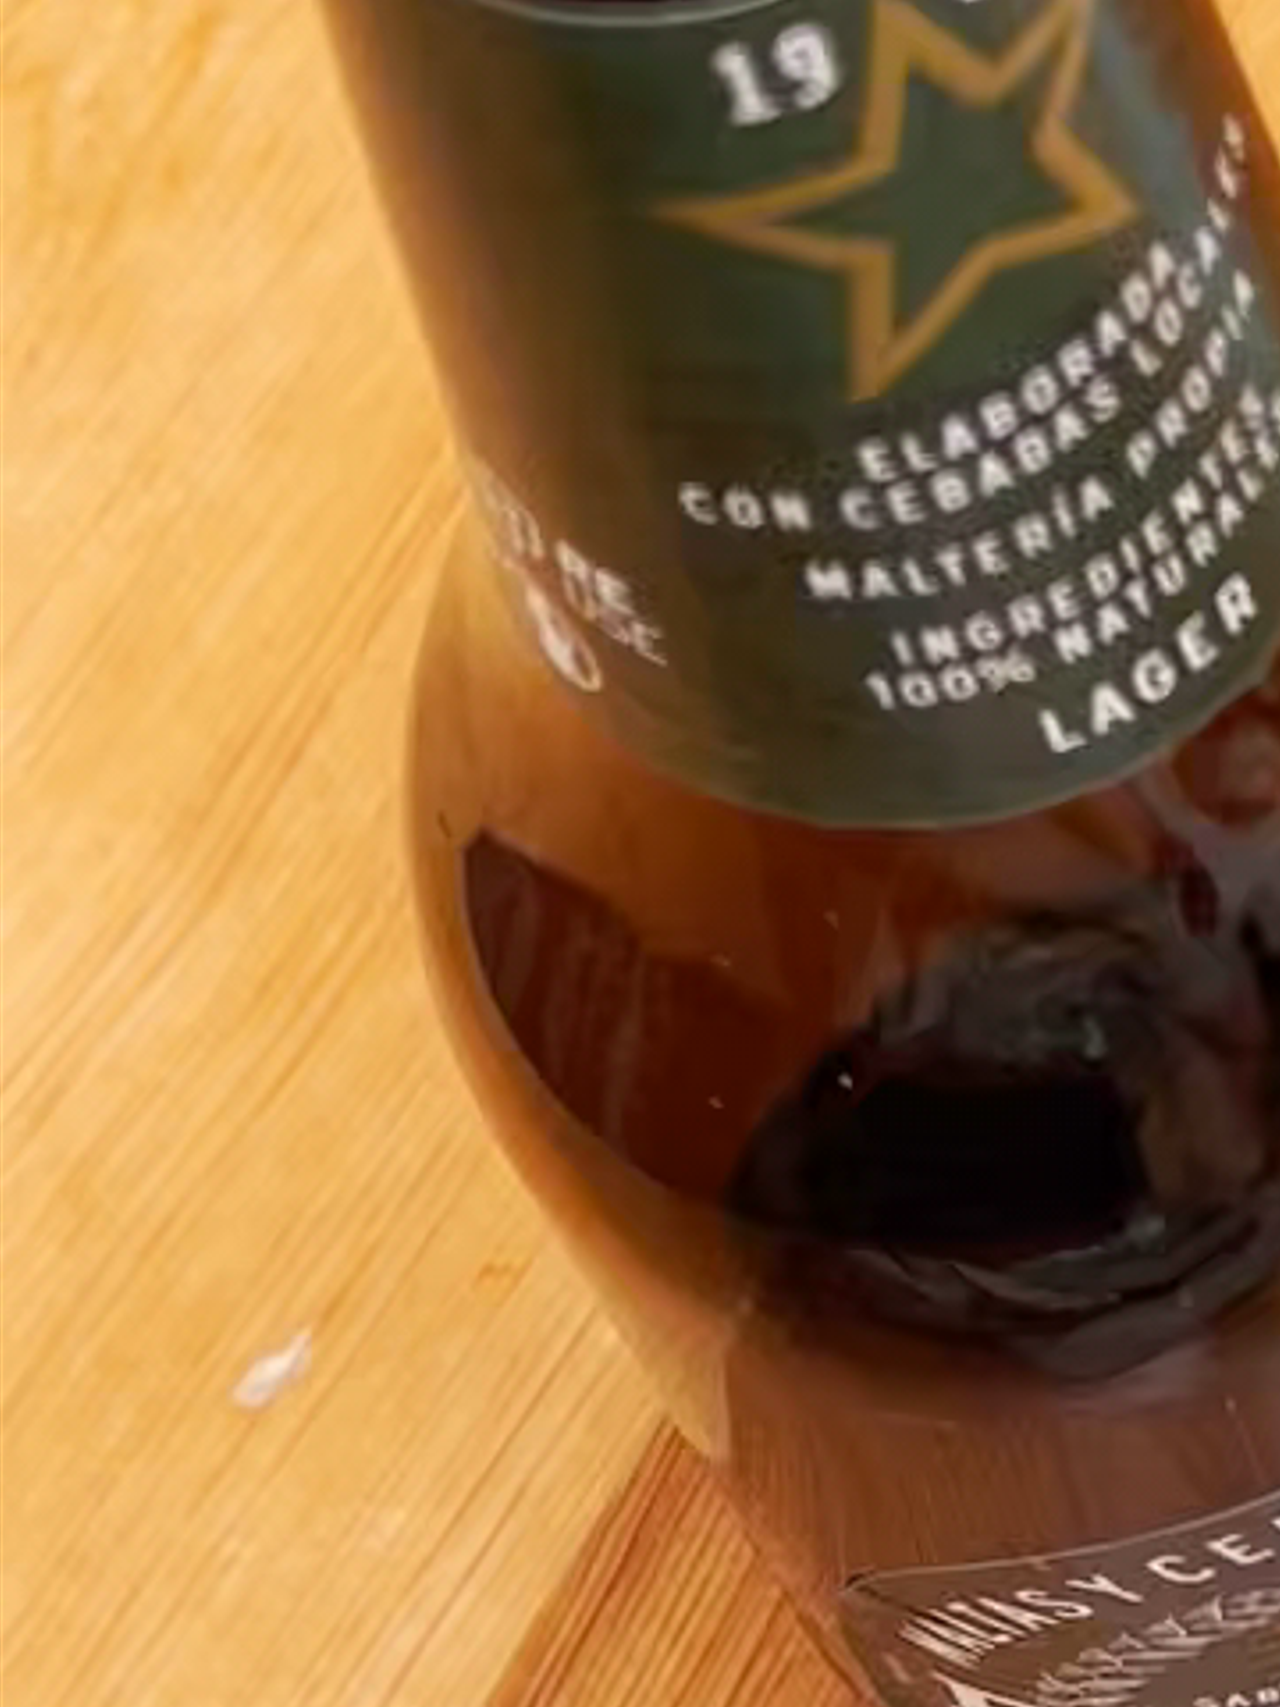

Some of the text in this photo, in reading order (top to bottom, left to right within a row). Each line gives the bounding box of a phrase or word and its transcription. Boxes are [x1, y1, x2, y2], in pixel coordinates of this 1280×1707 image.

[711, 22, 840, 126] 19
[857, 239, 1176, 483] ELABORADA
[1125, 268, 1255, 480] PROPIA
[678, 480, 812, 532] CON
[838, 371, 1121, 531] CEBADAS
[864, 643, 1037, 711] 100%
[1038, 572, 1259, 756] LAGER
